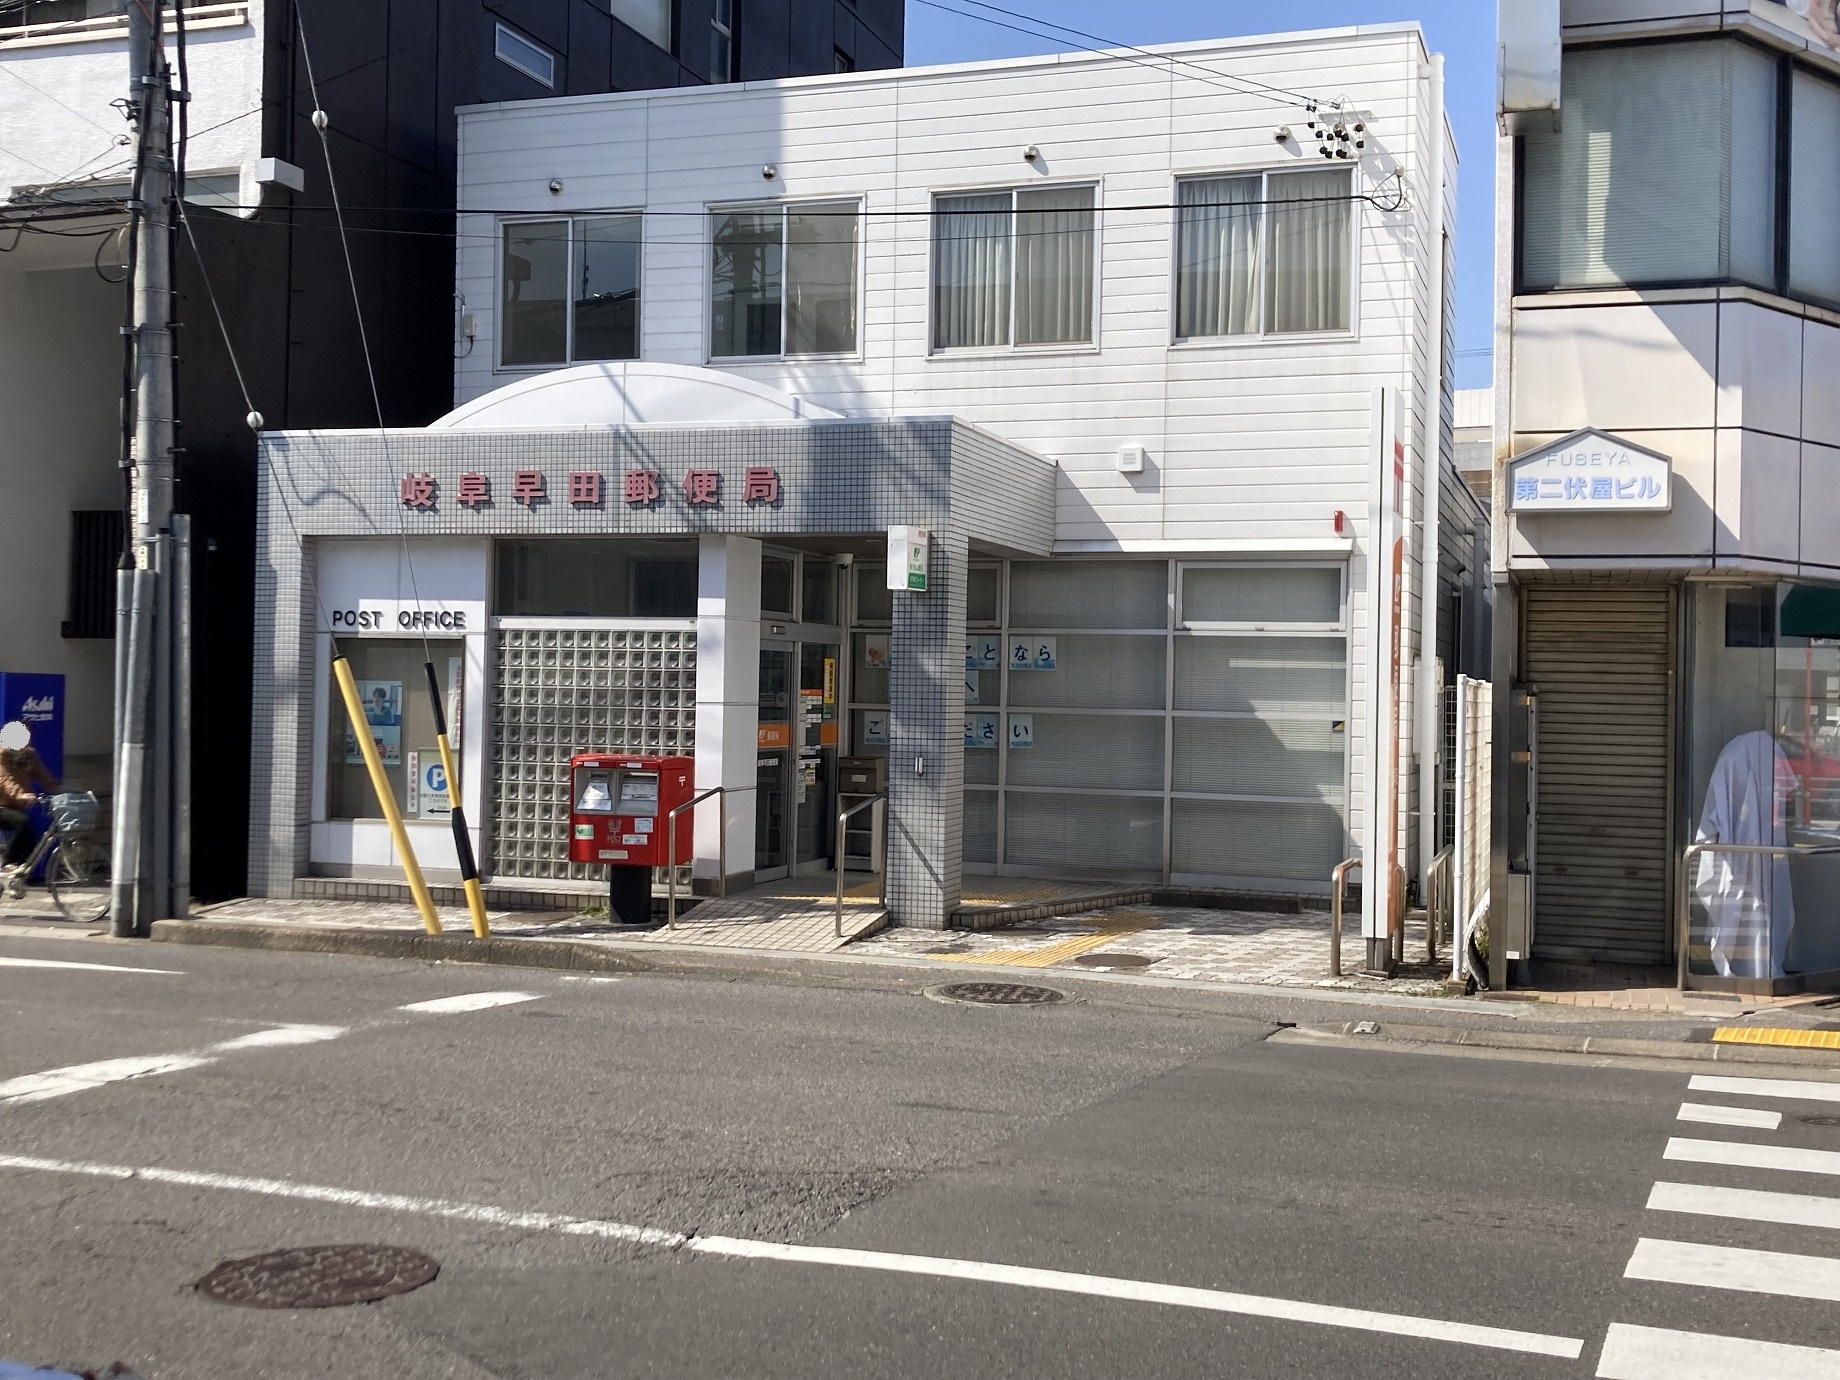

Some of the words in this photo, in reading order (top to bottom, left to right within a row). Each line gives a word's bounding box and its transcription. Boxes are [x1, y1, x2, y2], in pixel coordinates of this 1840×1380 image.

[1546, 451, 1632, 467] FUSEYA
[401, 466, 778, 507] 岐阜早田郵便局
[1516, 475, 1662, 501] 第二伏屋ビル
[332, 610, 382, 627] POST
[398, 610, 466, 627] OFFICE
